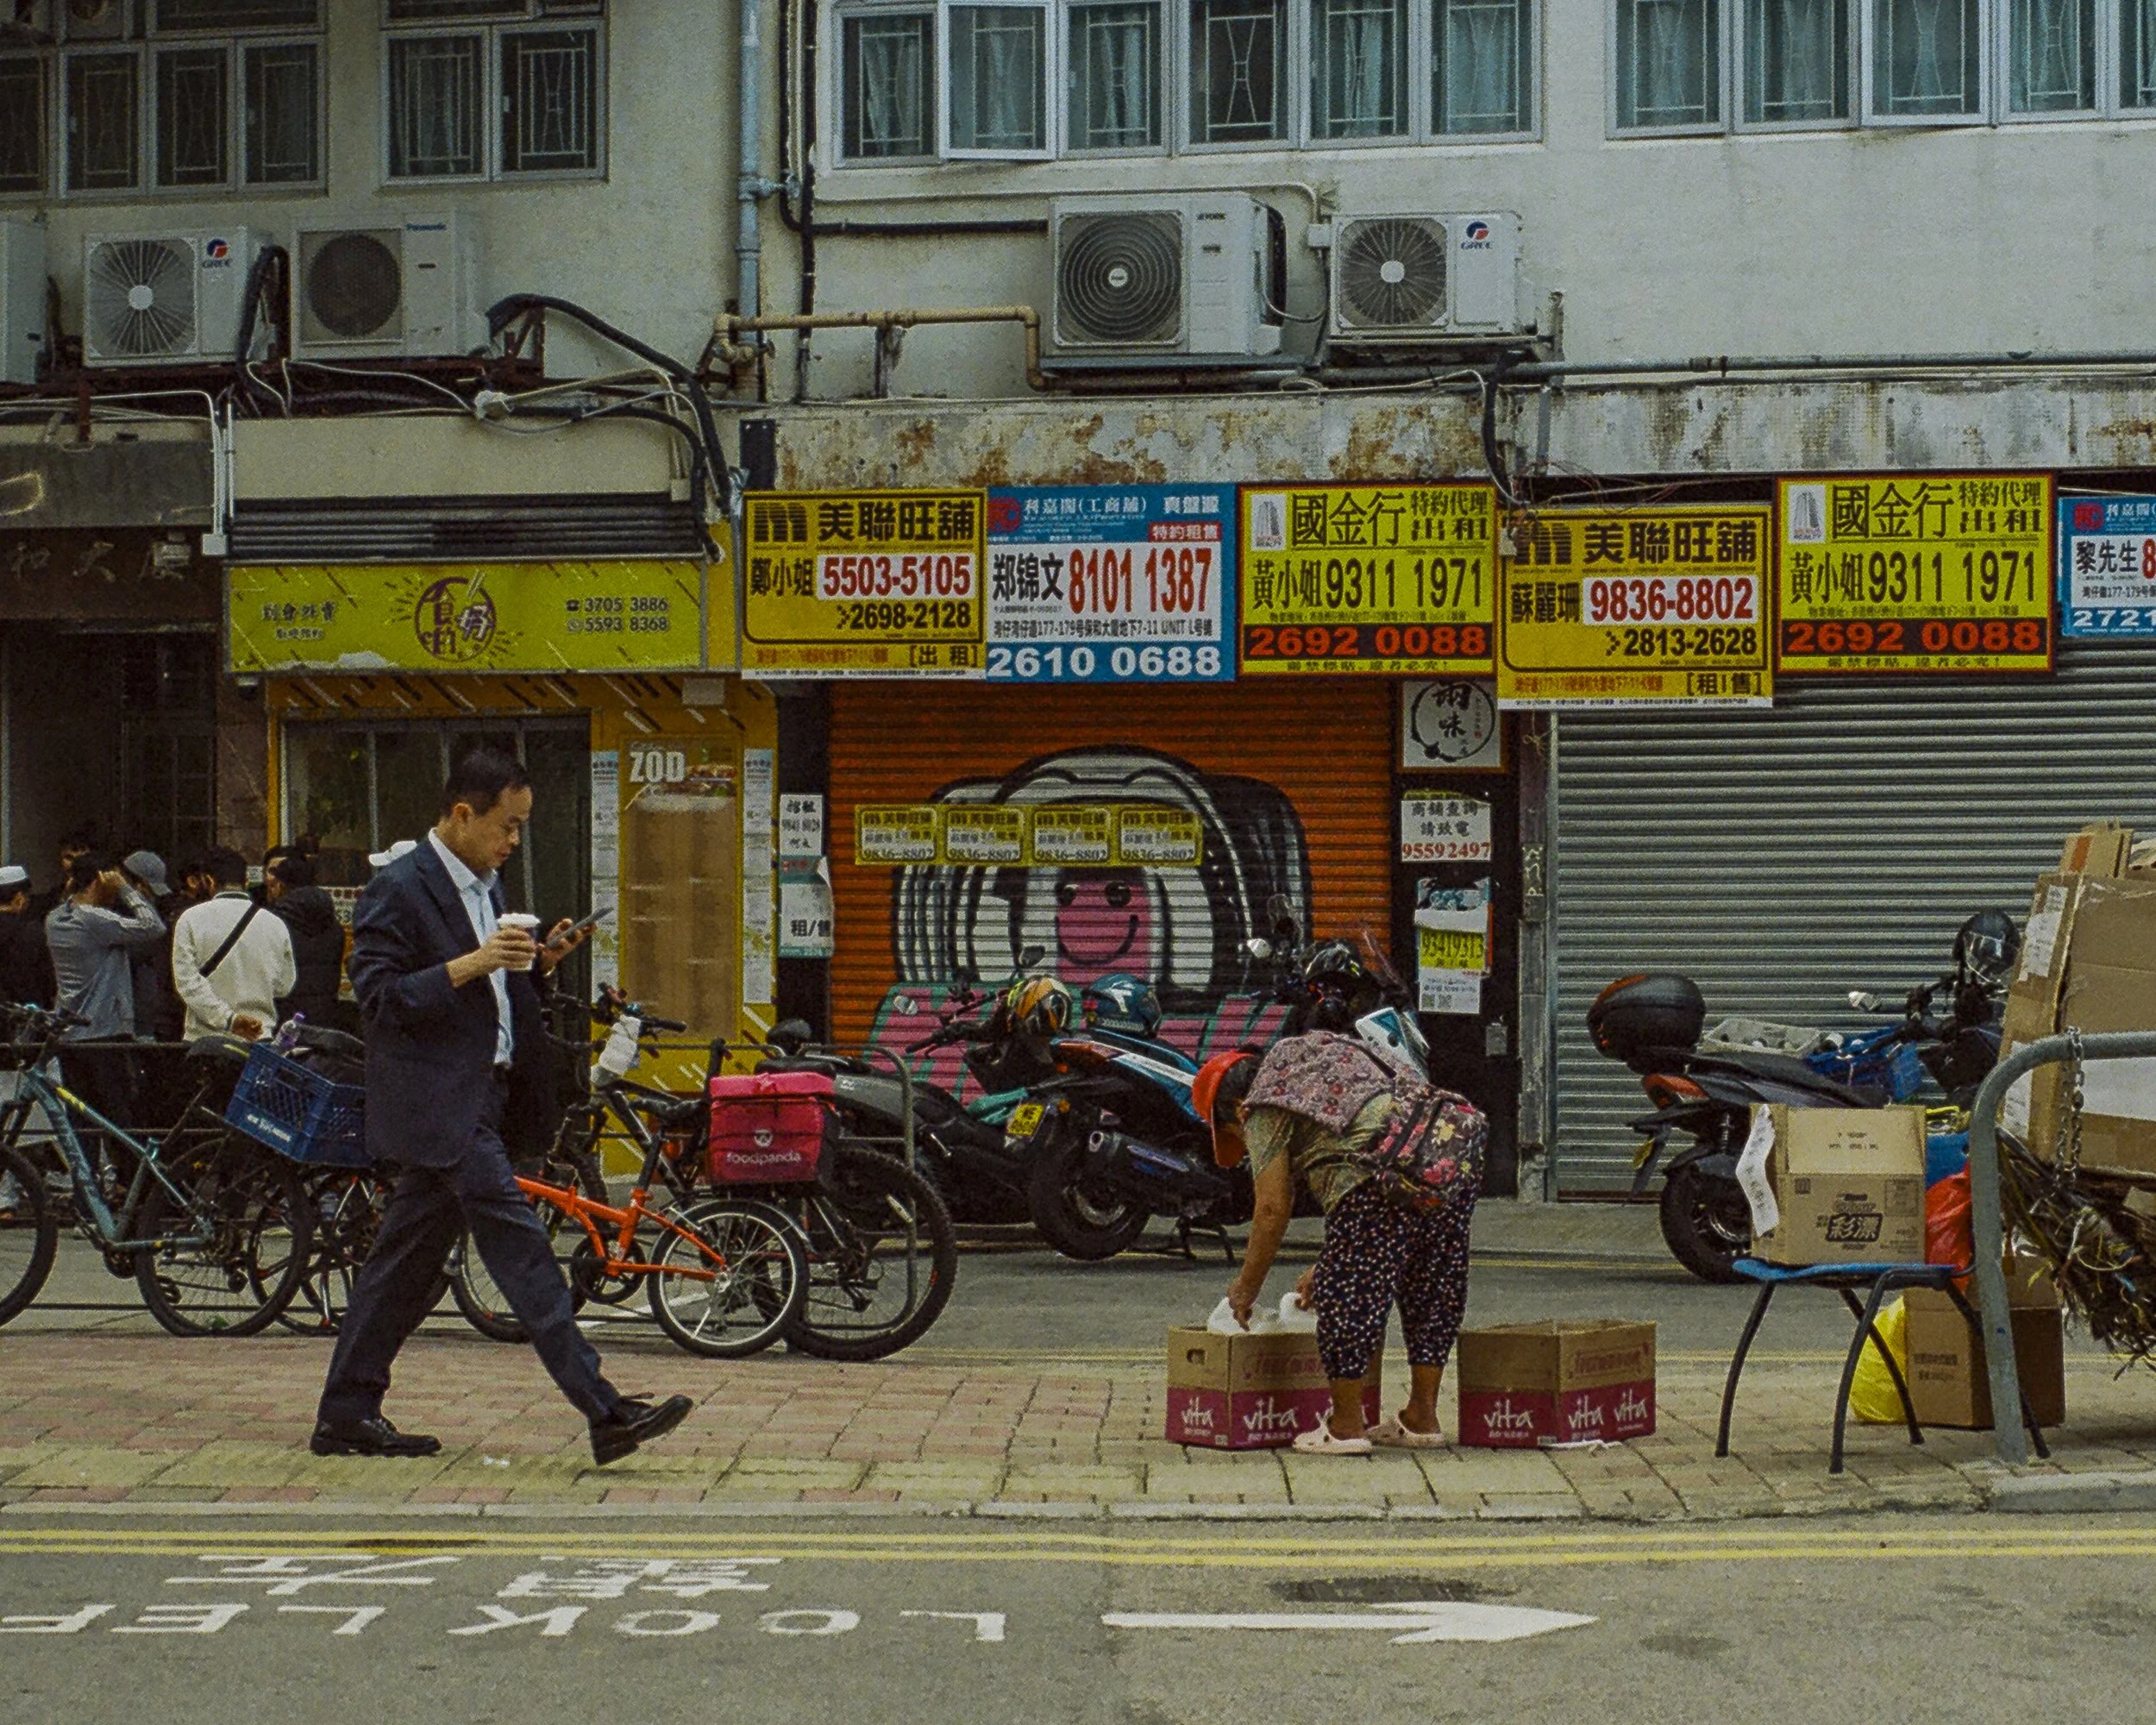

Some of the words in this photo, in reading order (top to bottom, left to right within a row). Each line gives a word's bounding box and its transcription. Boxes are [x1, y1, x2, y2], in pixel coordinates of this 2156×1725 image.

[1410, 490, 1489, 517] 特約代理
[1833, 482, 1955, 539] 國金行
[1959, 481, 2041, 508] 特約代理
[819, 500, 975, 542] 美聯旺舖
[1293, 491, 1407, 547] 國金行
[1583, 520, 1758, 563] 美聯旺舖
[750, 557, 815, 597] 鄭小姐
[1069, 548, 1132, 614] 8101
[1144, 547, 1213, 613] 1387
[1252, 557, 1322, 610] 黃小姐
[1326, 557, 1395, 608] 9311
[1413, 557, 1482, 608] 1971
[1790, 550, 1865, 604] 黃小姐
[1868, 550, 1942, 603] 9311
[1962, 550, 2034, 603] 1971
[585, 597, 623, 612] 3705
[630, 596, 669, 612] 3886
[849, 603, 972, 630] 2698-2128
[1590, 578, 1754, 623] 9836-8802
[585, 616, 623, 632] 5593
[629, 616, 669, 632] 8368
[1787, 621, 1904, 652] 2692
[1921, 621, 2041, 652] 0088
[1250, 626, 1359, 656] 2692
[1375, 626, 1487, 656] 0088
[1623, 627, 1758, 657] 2813-2628
[987, 646, 1096, 678] 2610
[1111, 646, 1222, 678] 0688
[1402, 841, 1445, 859] 9559
[1448, 840, 1490, 859] 2497
[726, 1149, 802, 1165] foodpanda
[1181, 1395, 1214, 1428] vita
[1243, 1395, 1300, 1431] vita
[1483, 1397, 1534, 1429] vita
[1567, 1393, 1605, 1429] vita
[447, 1604, 1006, 1641] LOOK
